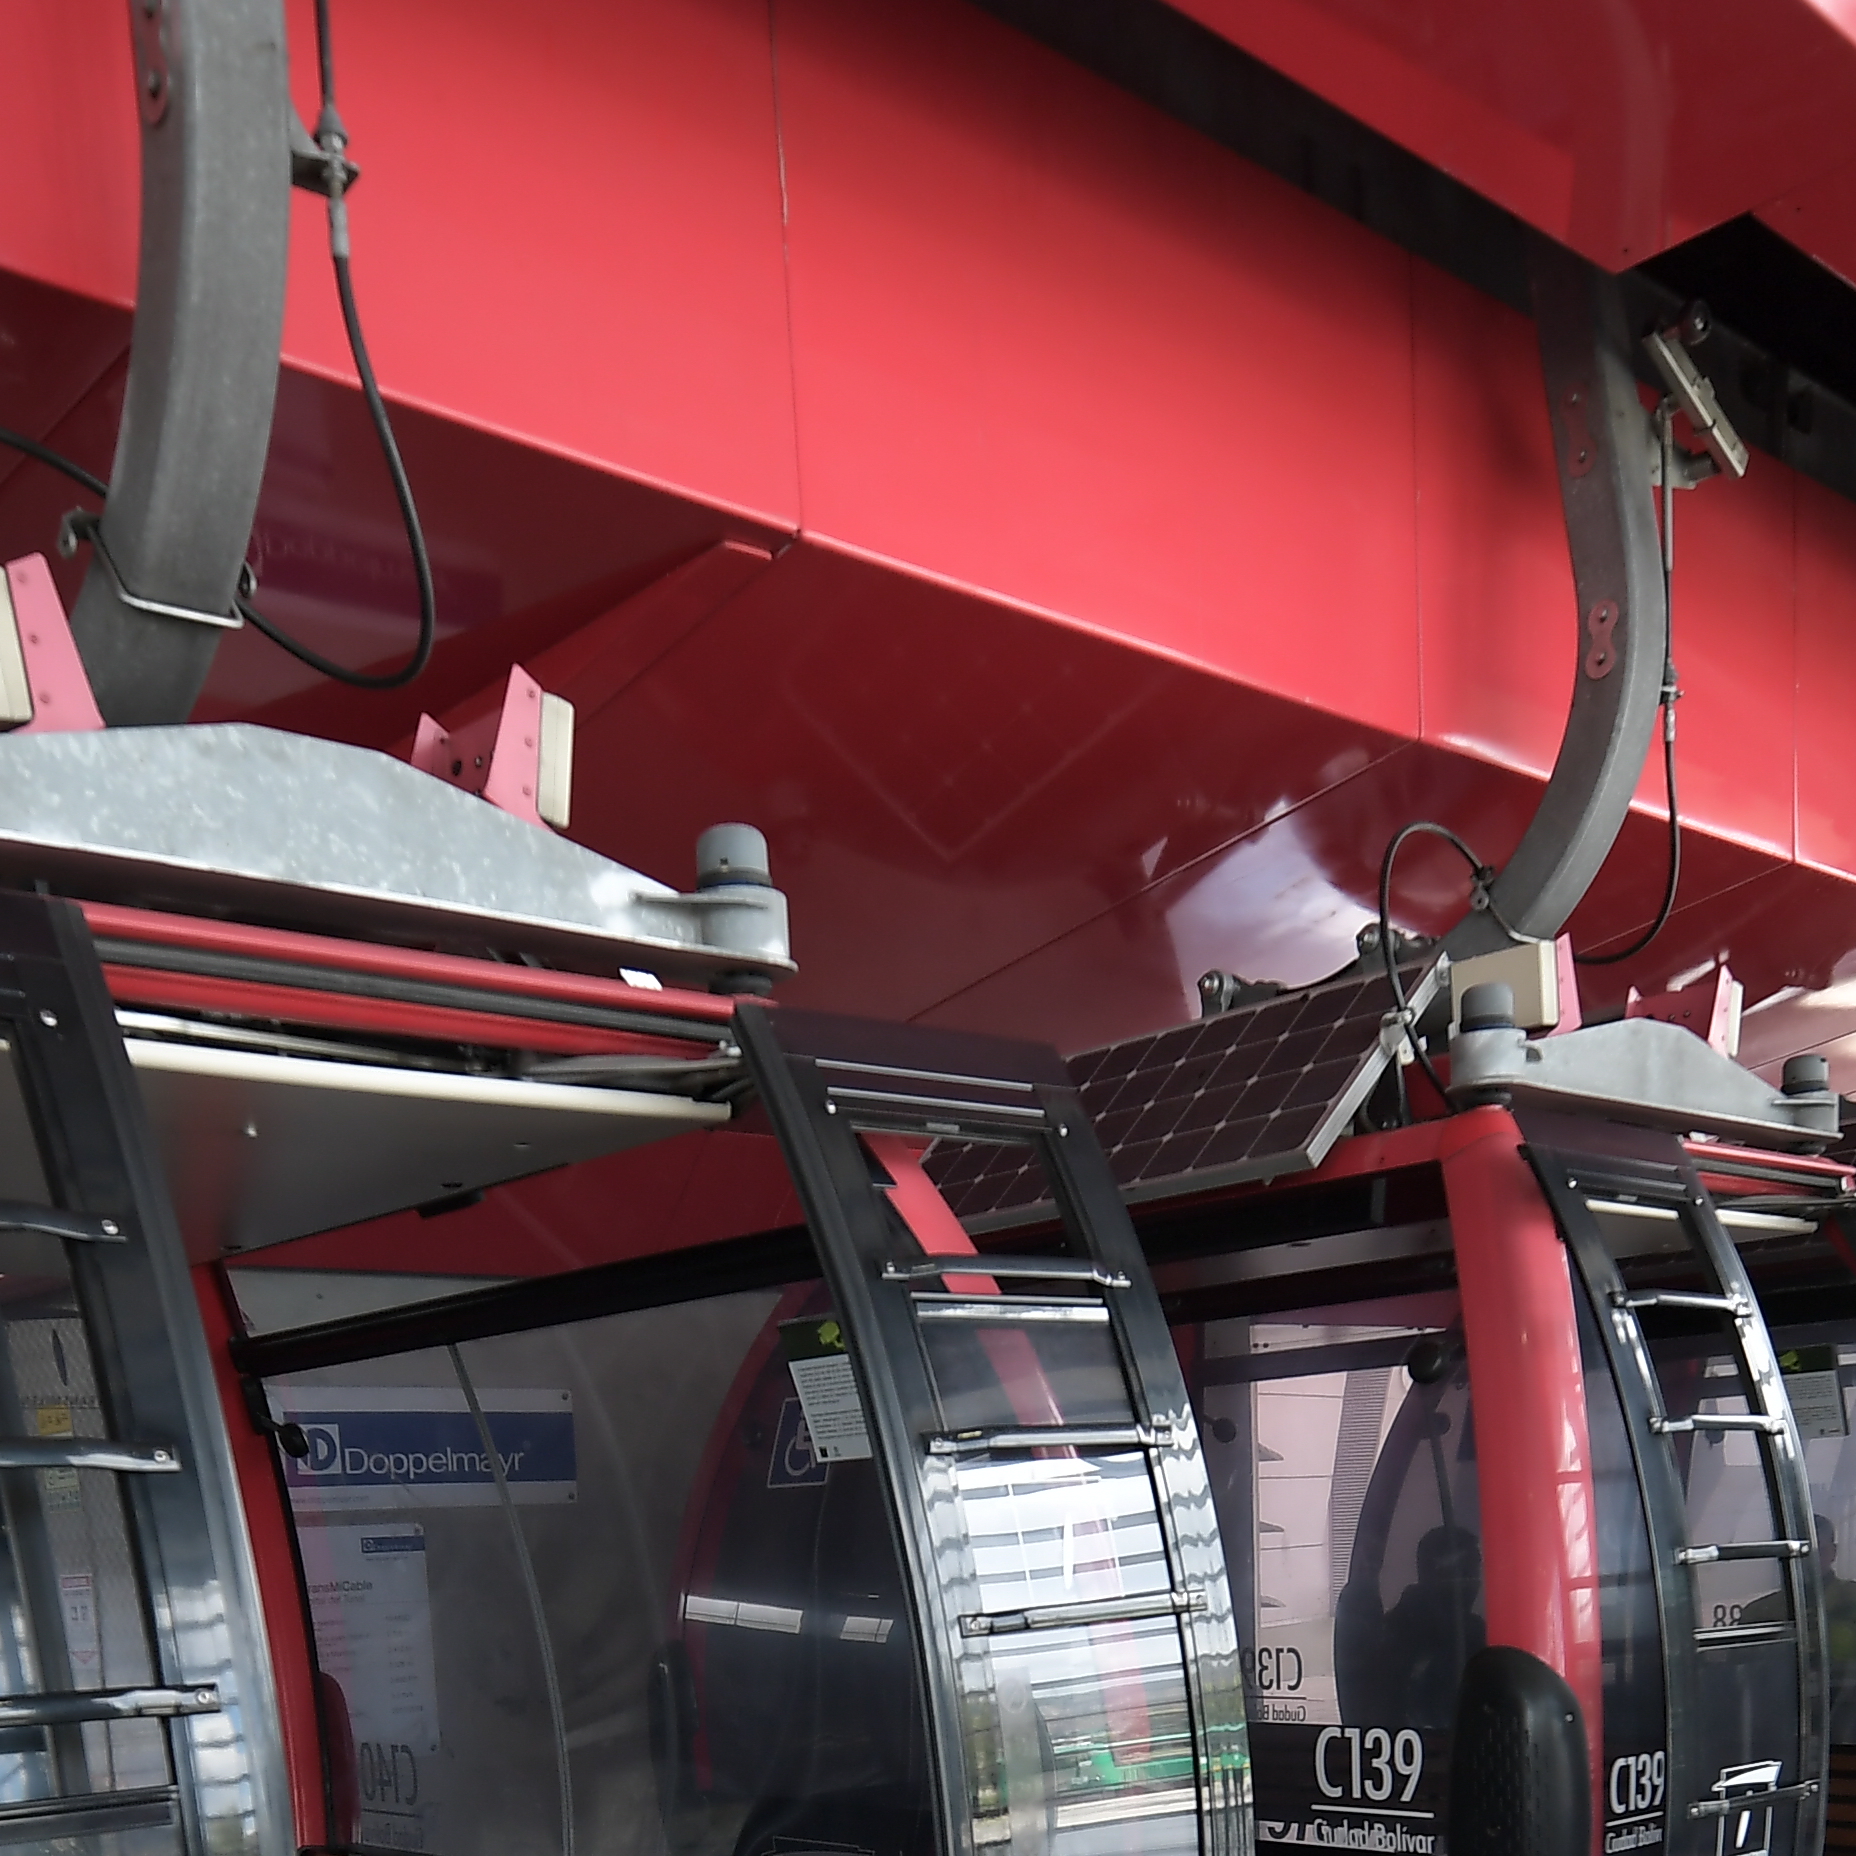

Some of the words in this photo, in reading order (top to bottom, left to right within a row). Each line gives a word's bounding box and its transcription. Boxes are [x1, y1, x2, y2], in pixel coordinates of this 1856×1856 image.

[344, 1446, 525, 1479] Doppelmayr
[308, 1579, 374, 1594] ransMiCable
[1314, 1726, 1425, 1803] C139
[1609, 1750, 1666, 1815] C139
[1313, 1818, 1369, 1847] Ciudad
[1372, 1823, 1435, 1855] Bolívar
